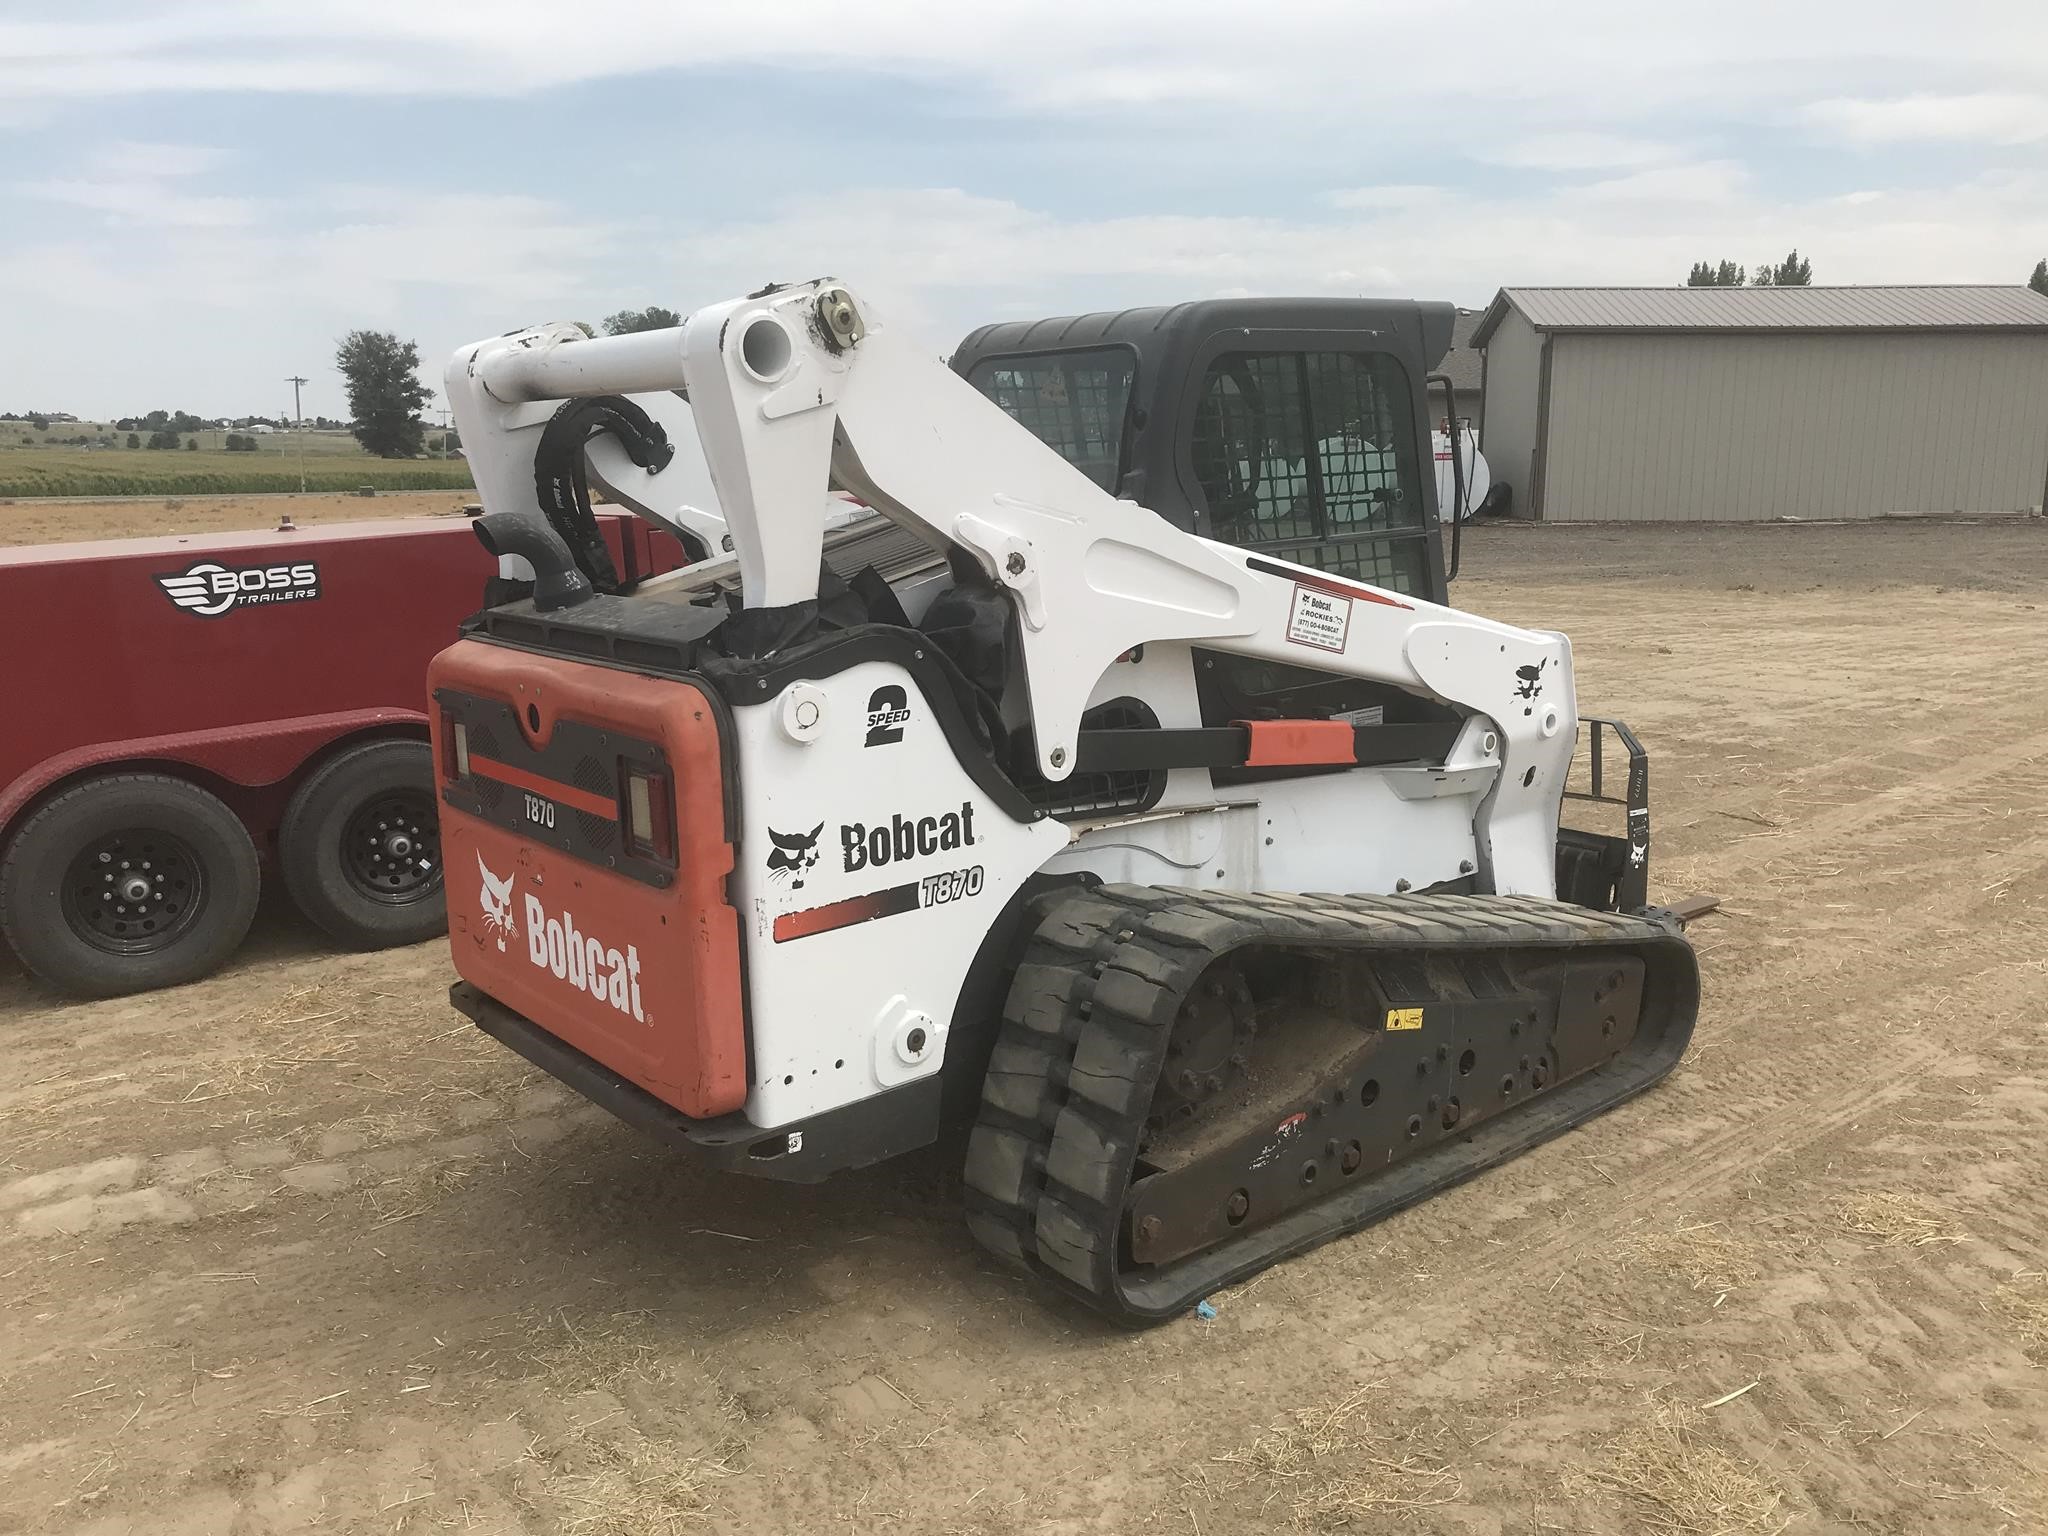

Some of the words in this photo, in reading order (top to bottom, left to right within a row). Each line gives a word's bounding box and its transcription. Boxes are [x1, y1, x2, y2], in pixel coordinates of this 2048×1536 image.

[211, 564, 317, 594] BOSS
[237, 588, 317, 605] TRAILERS
[1311, 598, 1331, 611] Bobcat
[1306, 610, 1333, 622] ROCKIES
[864, 684, 908, 748] 2
[867, 709, 911, 727] SPEED
[524, 794, 555, 829] T870
[841, 801, 975, 872] Bobcat
[922, 864, 985, 909] T870
[524, 892, 645, 1023] Bobcat
